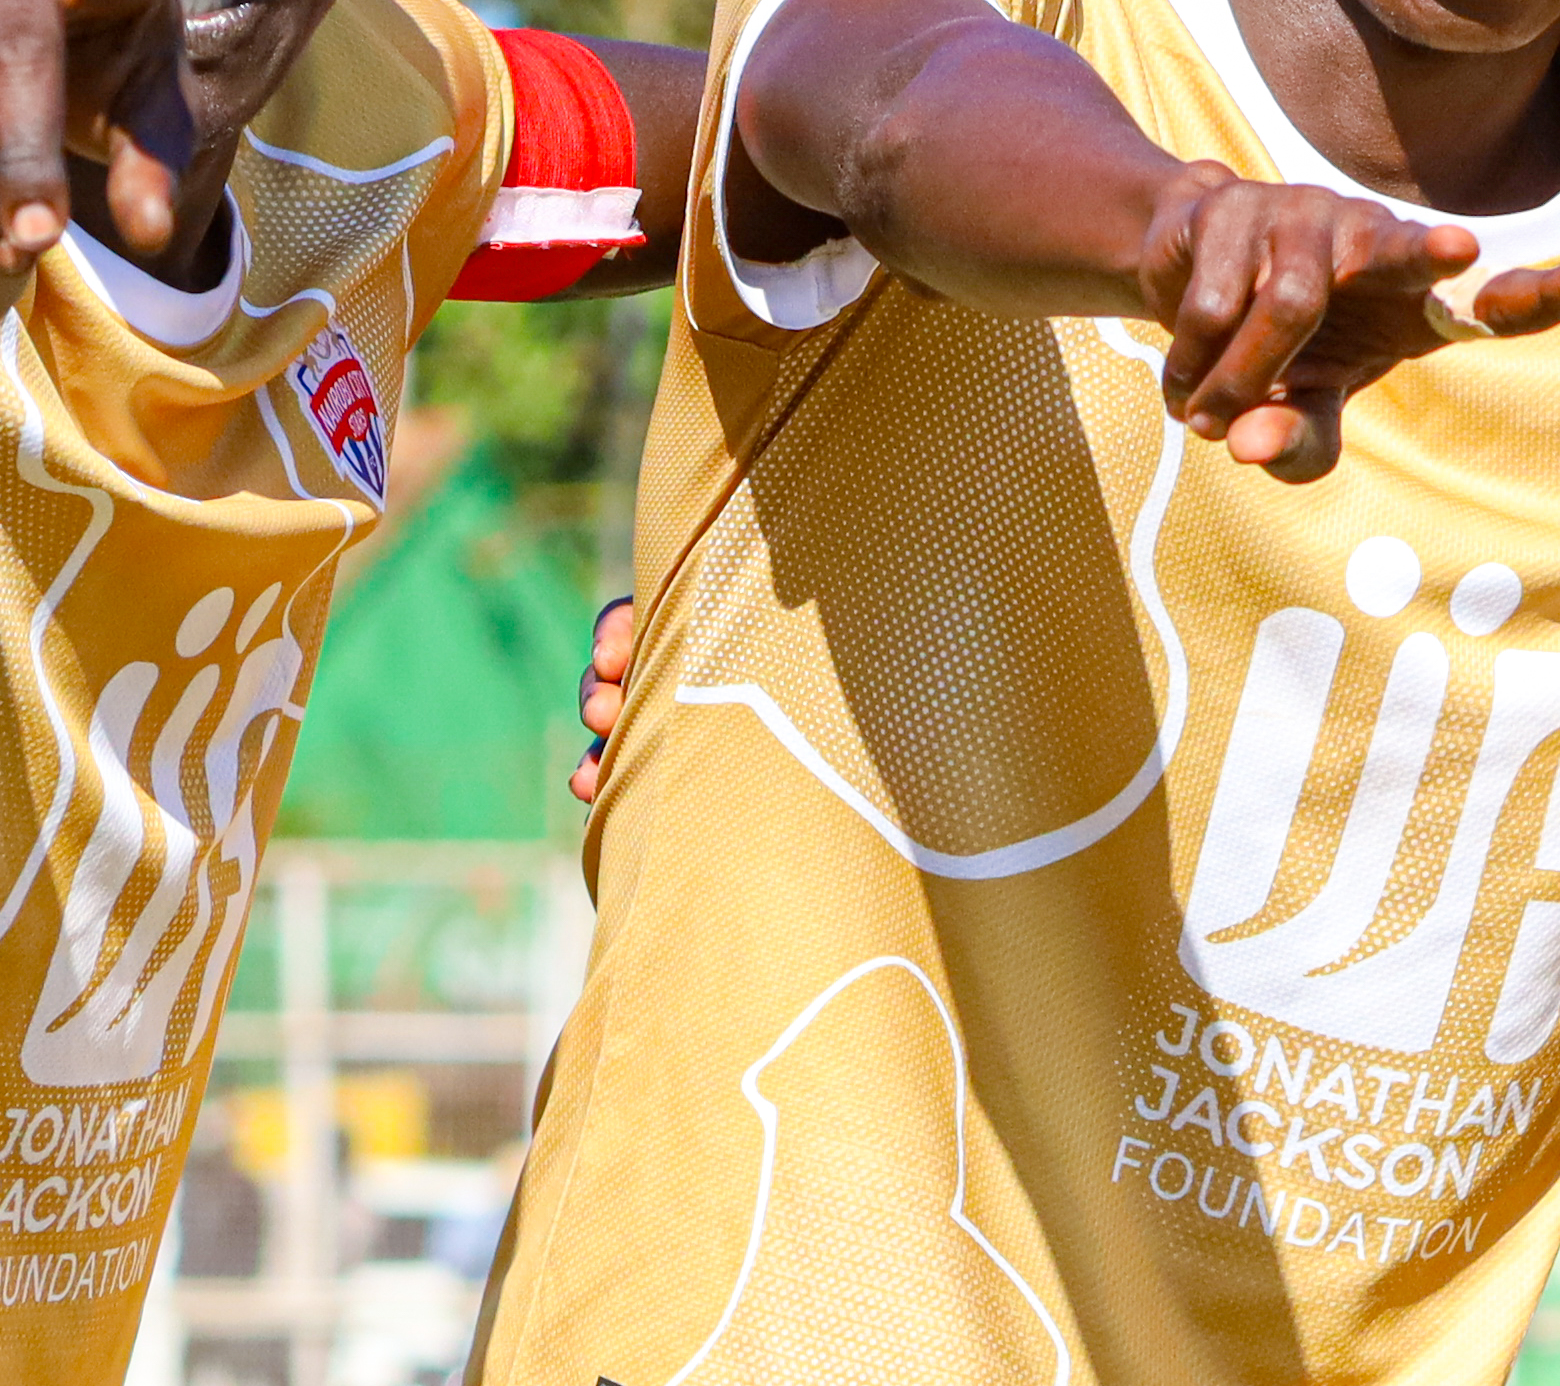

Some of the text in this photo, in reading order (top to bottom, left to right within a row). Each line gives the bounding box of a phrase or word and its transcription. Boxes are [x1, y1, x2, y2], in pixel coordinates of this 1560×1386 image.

[1134, 1065, 1485, 1201] JACKSON
[1155, 1001, 1542, 1137] JONATHAN
[1110, 1135, 1487, 1264] FOUNDATION
